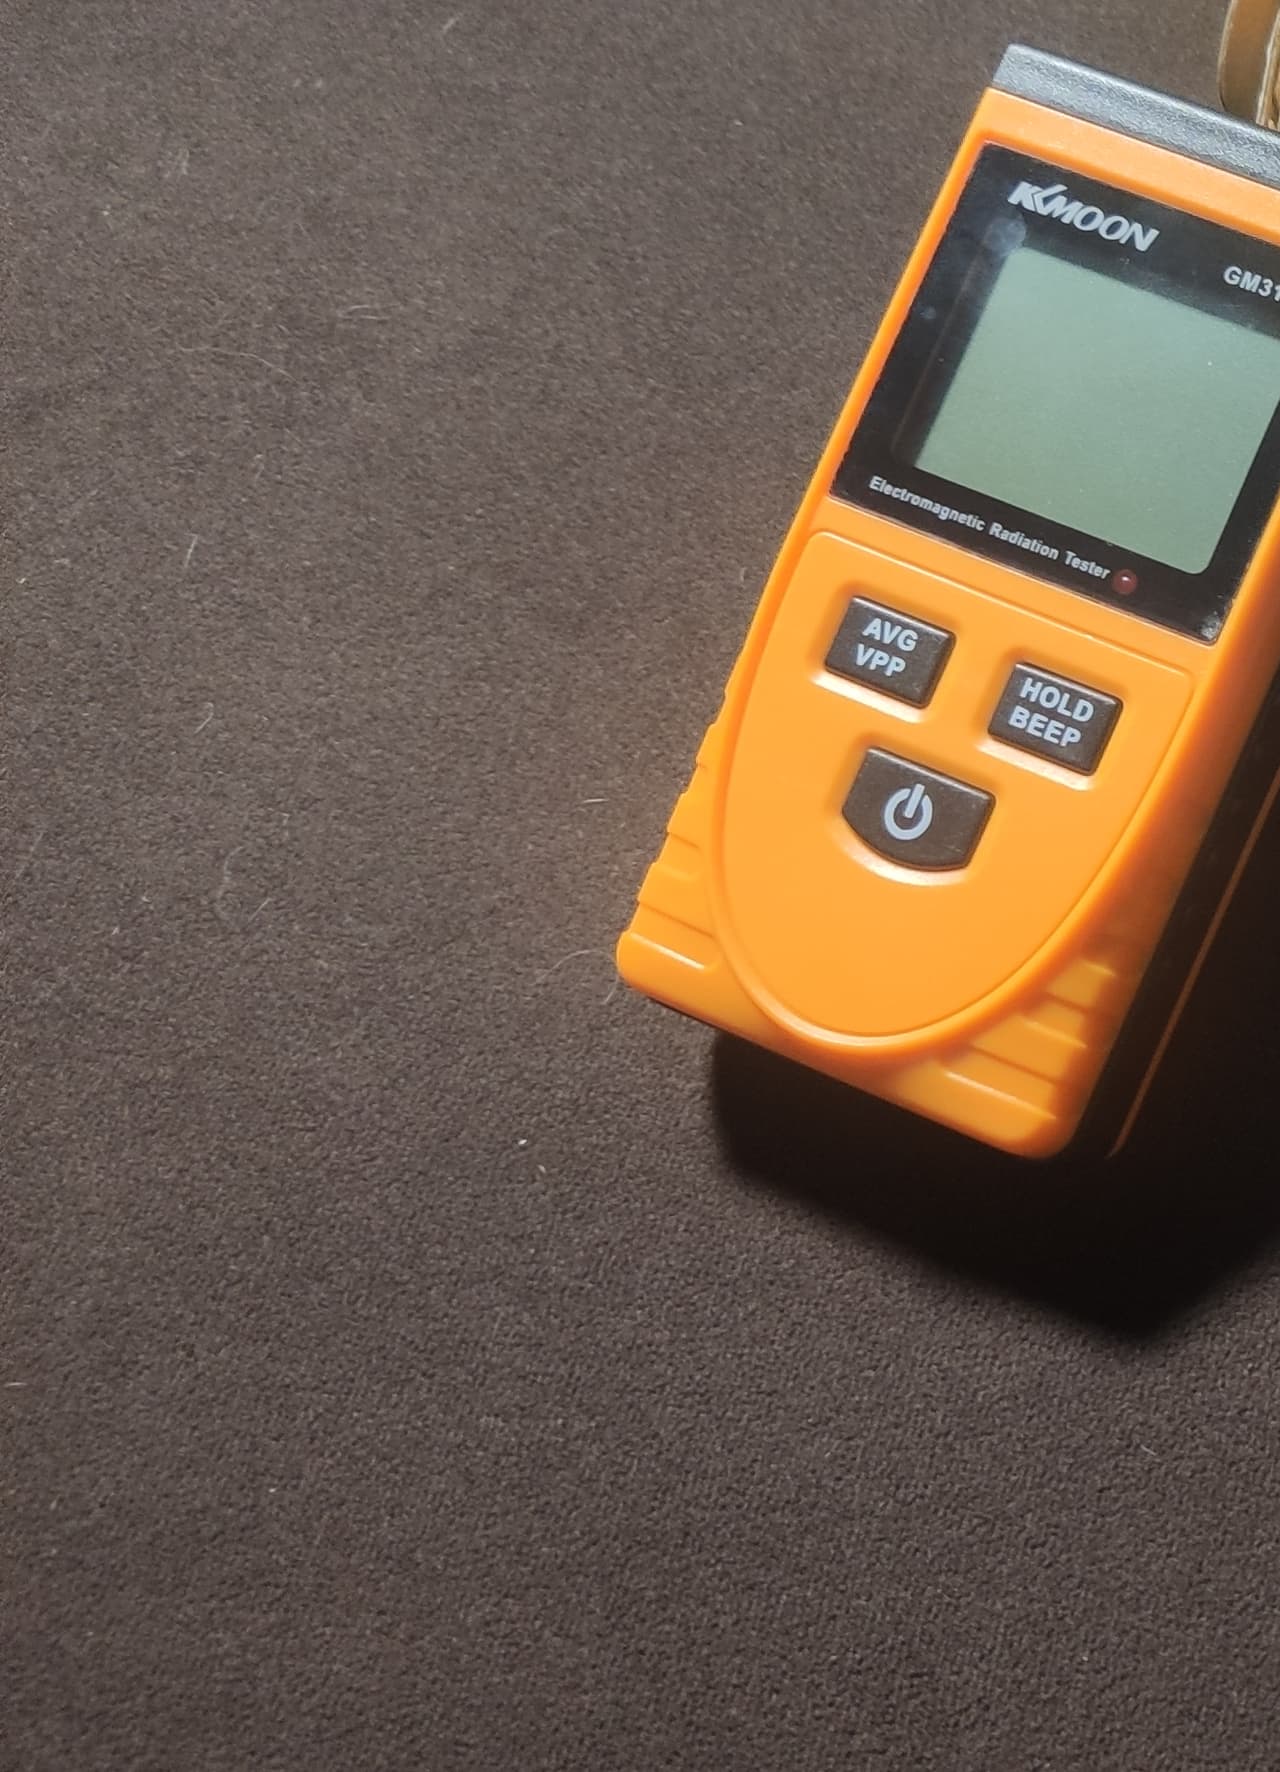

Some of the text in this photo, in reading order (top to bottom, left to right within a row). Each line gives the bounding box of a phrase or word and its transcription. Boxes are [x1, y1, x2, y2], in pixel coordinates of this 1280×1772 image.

[869, 475, 1111, 579] Electromagnetic Radiation Tester
[862, 617, 918, 652] AVG
[855, 643, 906, 677] VPP
[1020, 678, 1094, 722] HOLD
[1008, 706, 1082, 748] BEEP
